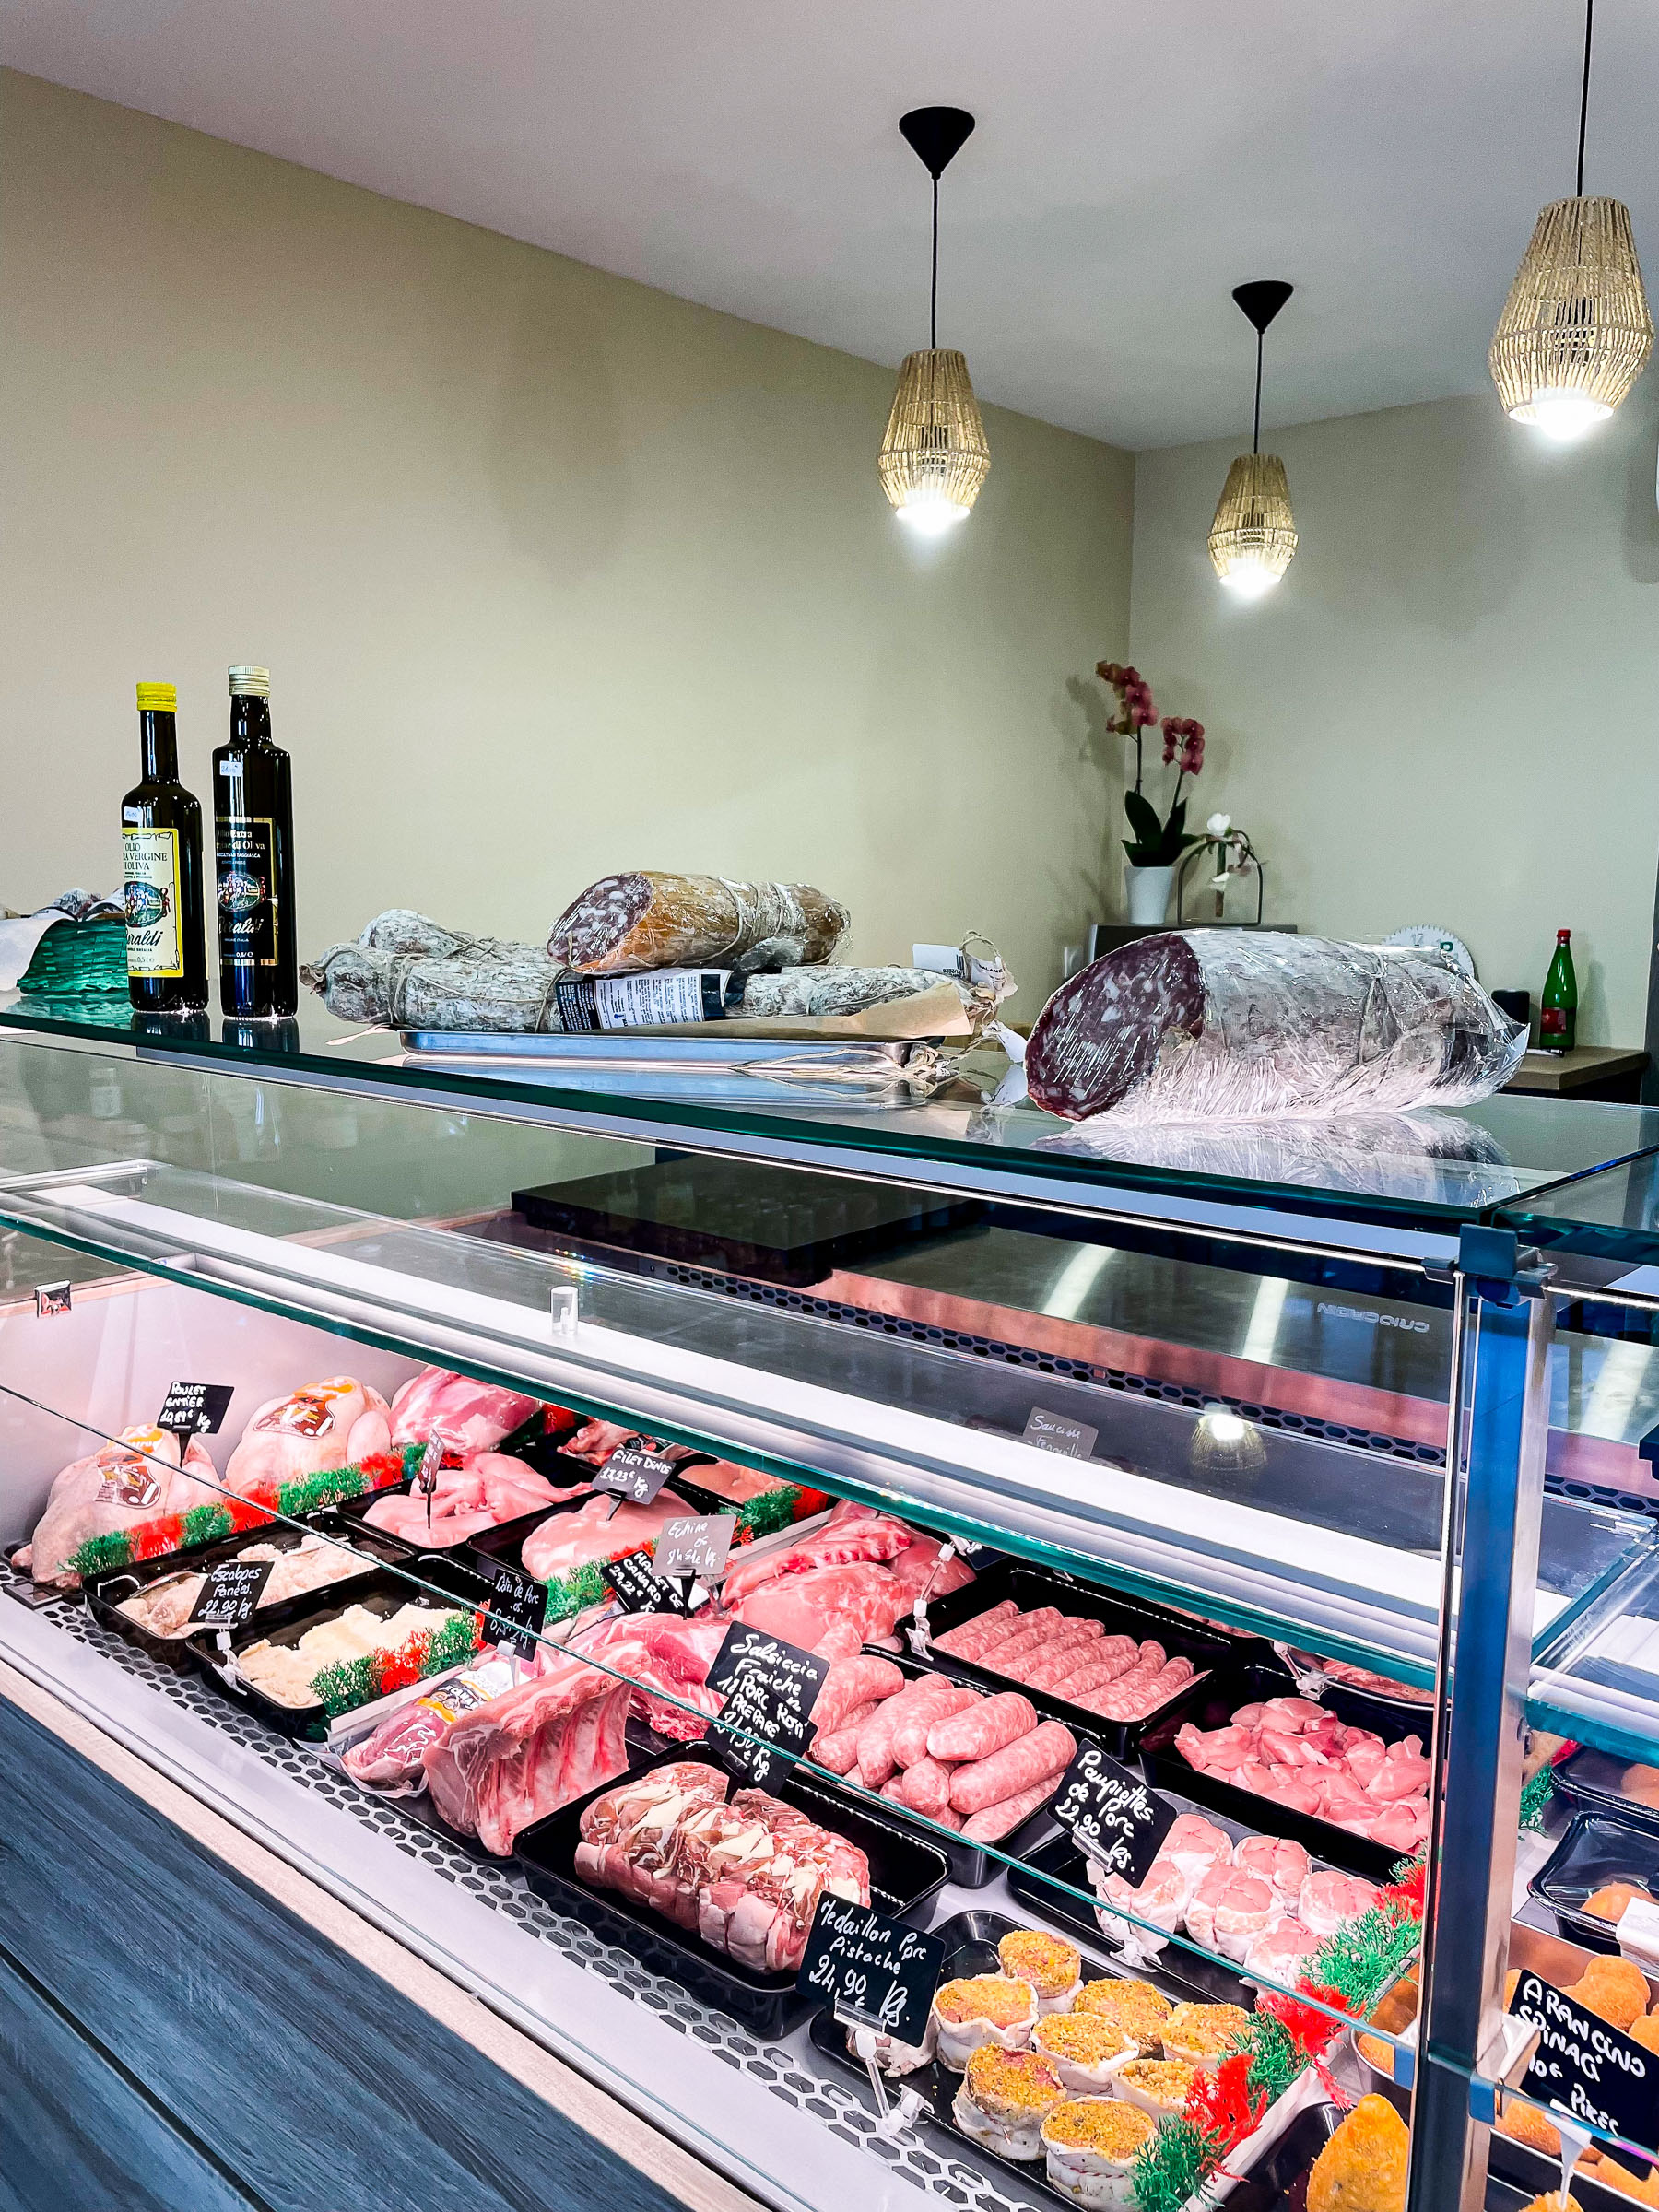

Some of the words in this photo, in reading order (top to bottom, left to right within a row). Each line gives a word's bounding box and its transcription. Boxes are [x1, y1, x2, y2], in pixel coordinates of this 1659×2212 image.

[131, 852, 168, 862] VERGINE
[612, 1449, 643, 1465] FILET
[623, 1558, 662, 1603] CANARD
[730, 1633, 818, 1680] Salsiccia
[739, 1674, 770, 1710] PORC
[1068, 1782, 1089, 1802] de
[1098, 1797, 1135, 1839] Porc
[830, 1936, 901, 1975] Pistache
[898, 1932, 927, 1961] Porc
[808, 1954, 867, 2000] 24,90
